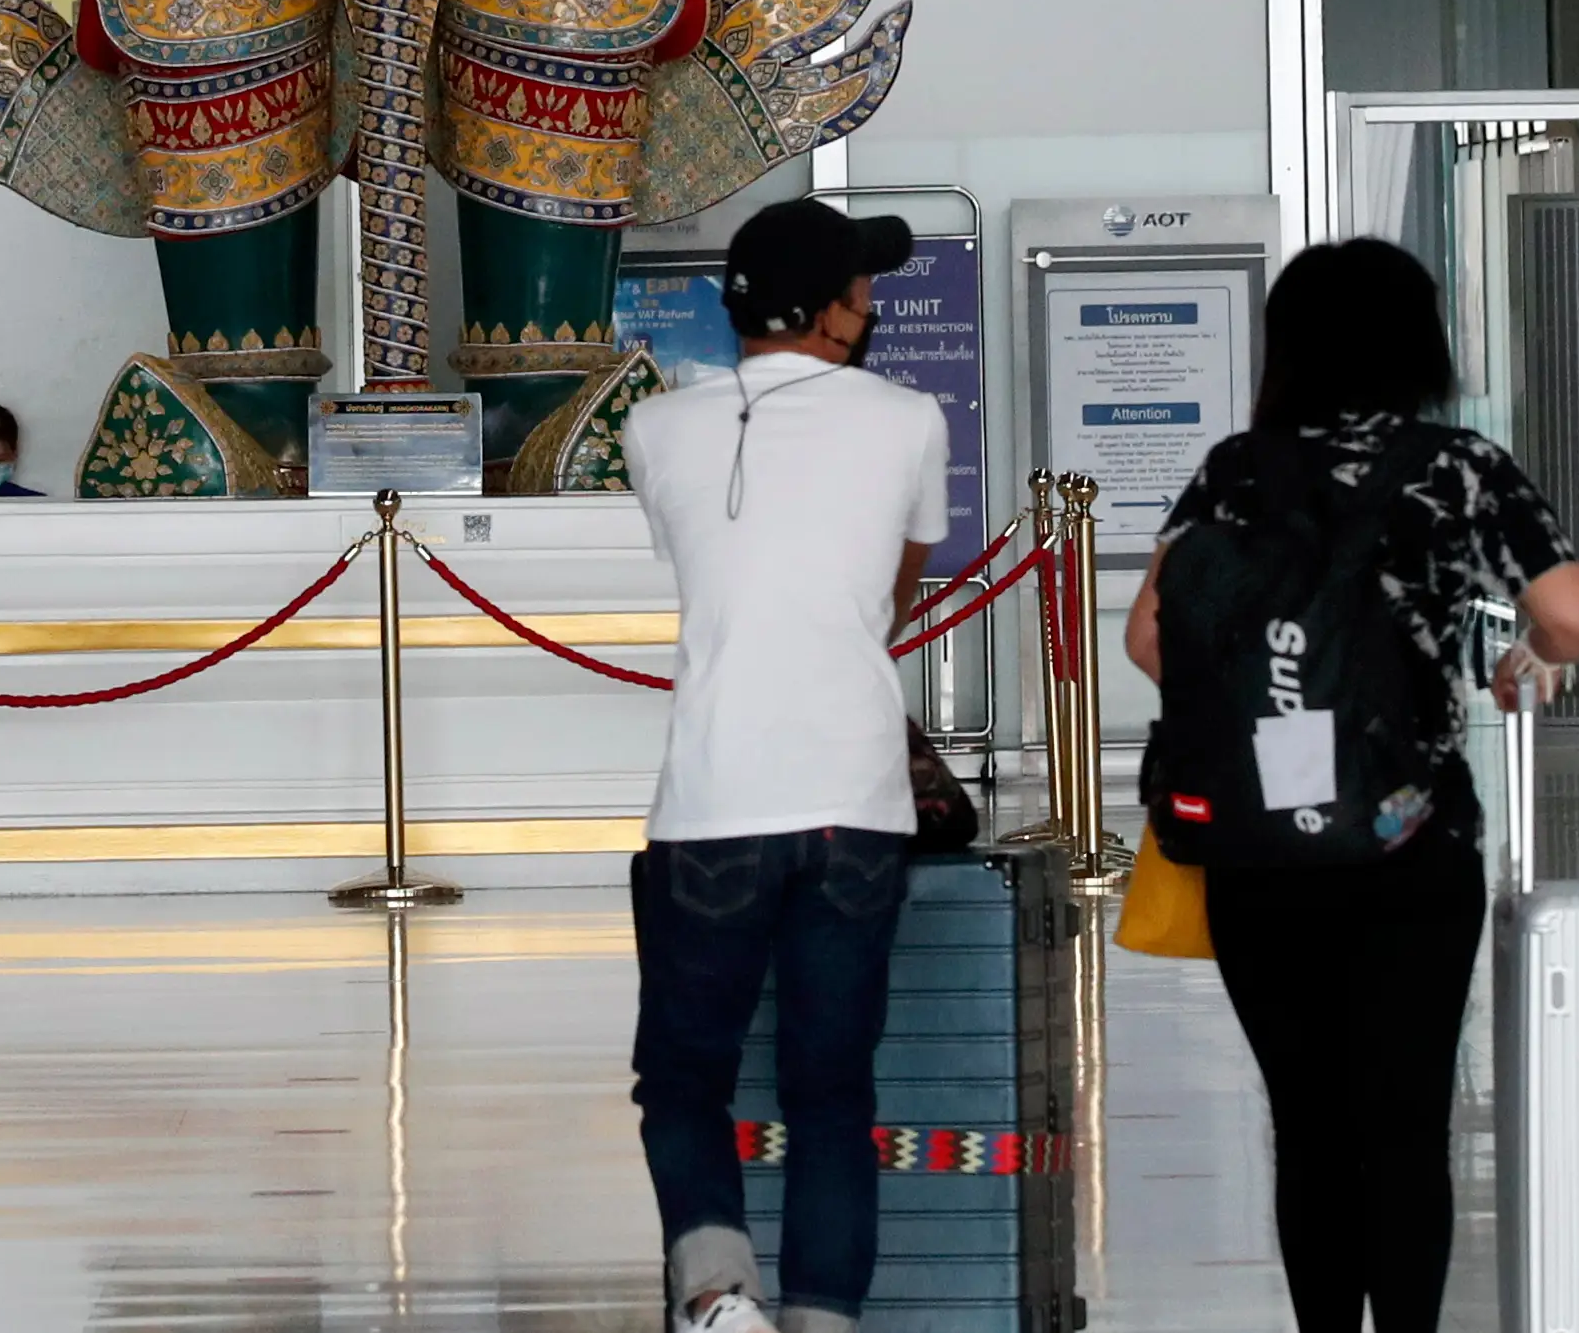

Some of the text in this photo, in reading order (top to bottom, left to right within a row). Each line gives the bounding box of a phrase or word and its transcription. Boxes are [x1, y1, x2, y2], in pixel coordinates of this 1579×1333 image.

[1142, 212, 1191, 228] AOT
[894, 299, 943, 317] UNIT
[899, 323, 974, 334] RESTRICTION
[1111, 407, 1171, 421] Attention
